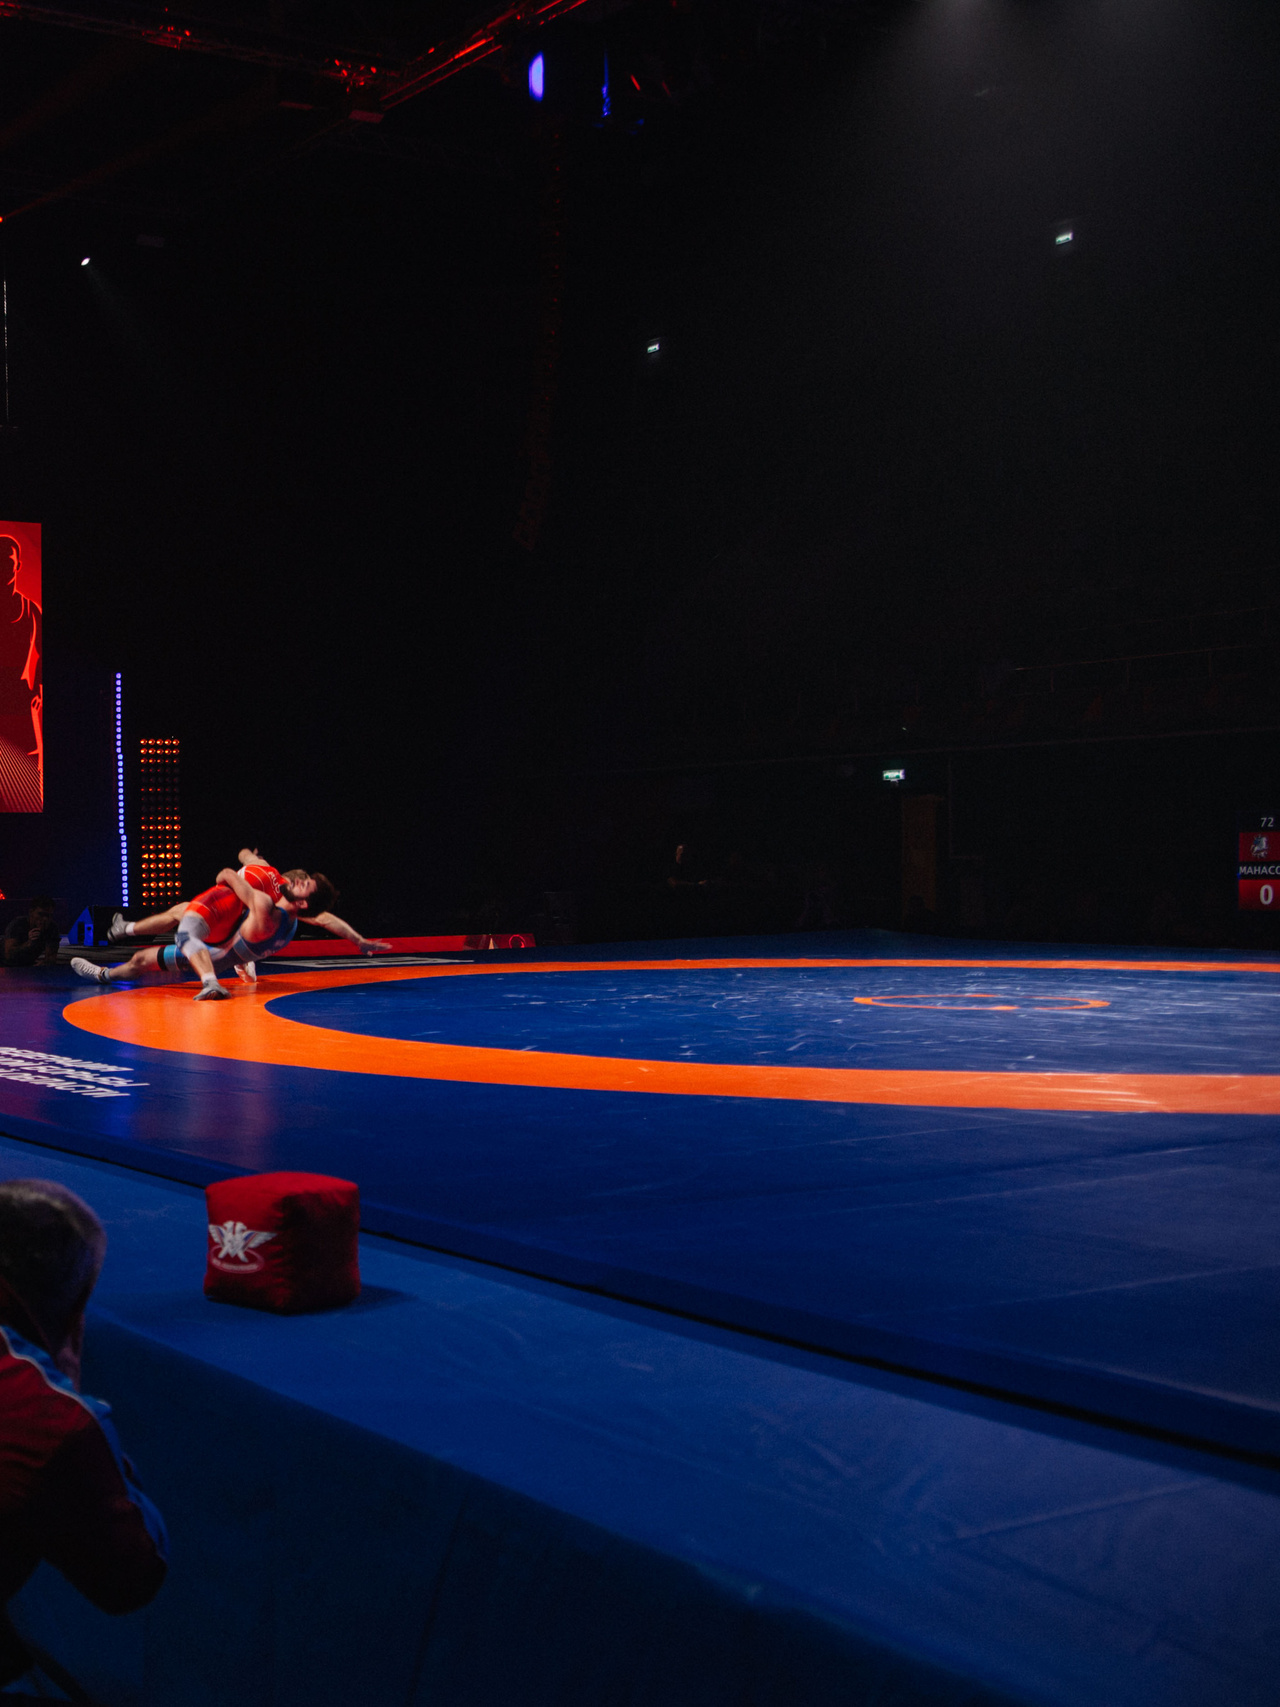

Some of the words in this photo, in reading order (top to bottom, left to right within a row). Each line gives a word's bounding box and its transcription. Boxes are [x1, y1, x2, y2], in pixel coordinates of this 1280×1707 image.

[1260, 817, 1275, 828] 72
[1260, 884, 1274, 905] 0
[20, 1065, 151, 1088] БОРЬБЫ
